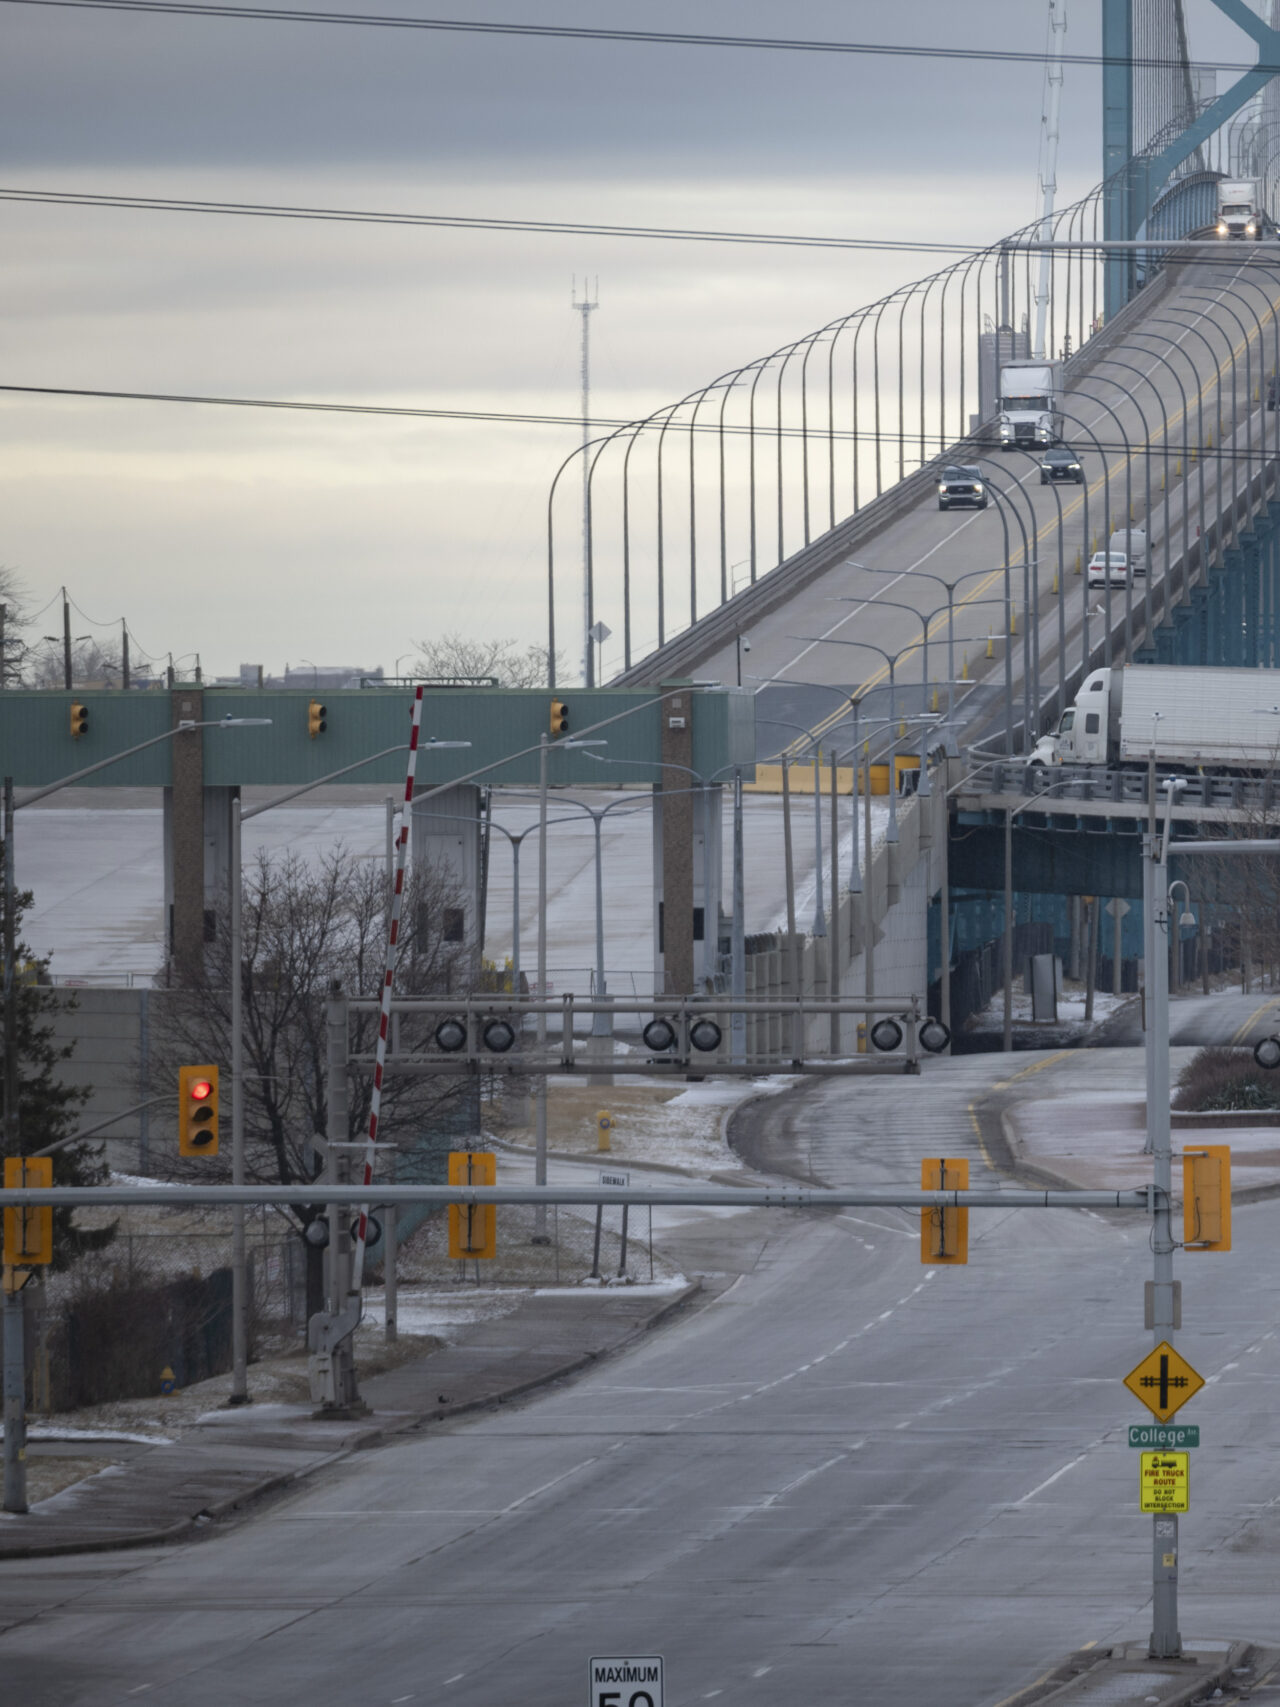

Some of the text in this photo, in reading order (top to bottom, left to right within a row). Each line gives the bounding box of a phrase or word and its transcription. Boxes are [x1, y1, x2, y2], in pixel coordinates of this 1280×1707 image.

[602, 1175, 625, 1186] SIDEWALK
[1130, 1428, 1185, 1446] College
[1144, 1469, 1184, 1477] FIRE TRUCK
[1153, 1478, 1176, 1486] ROUTE
[594, 1666, 658, 1683] MAXIMUM
